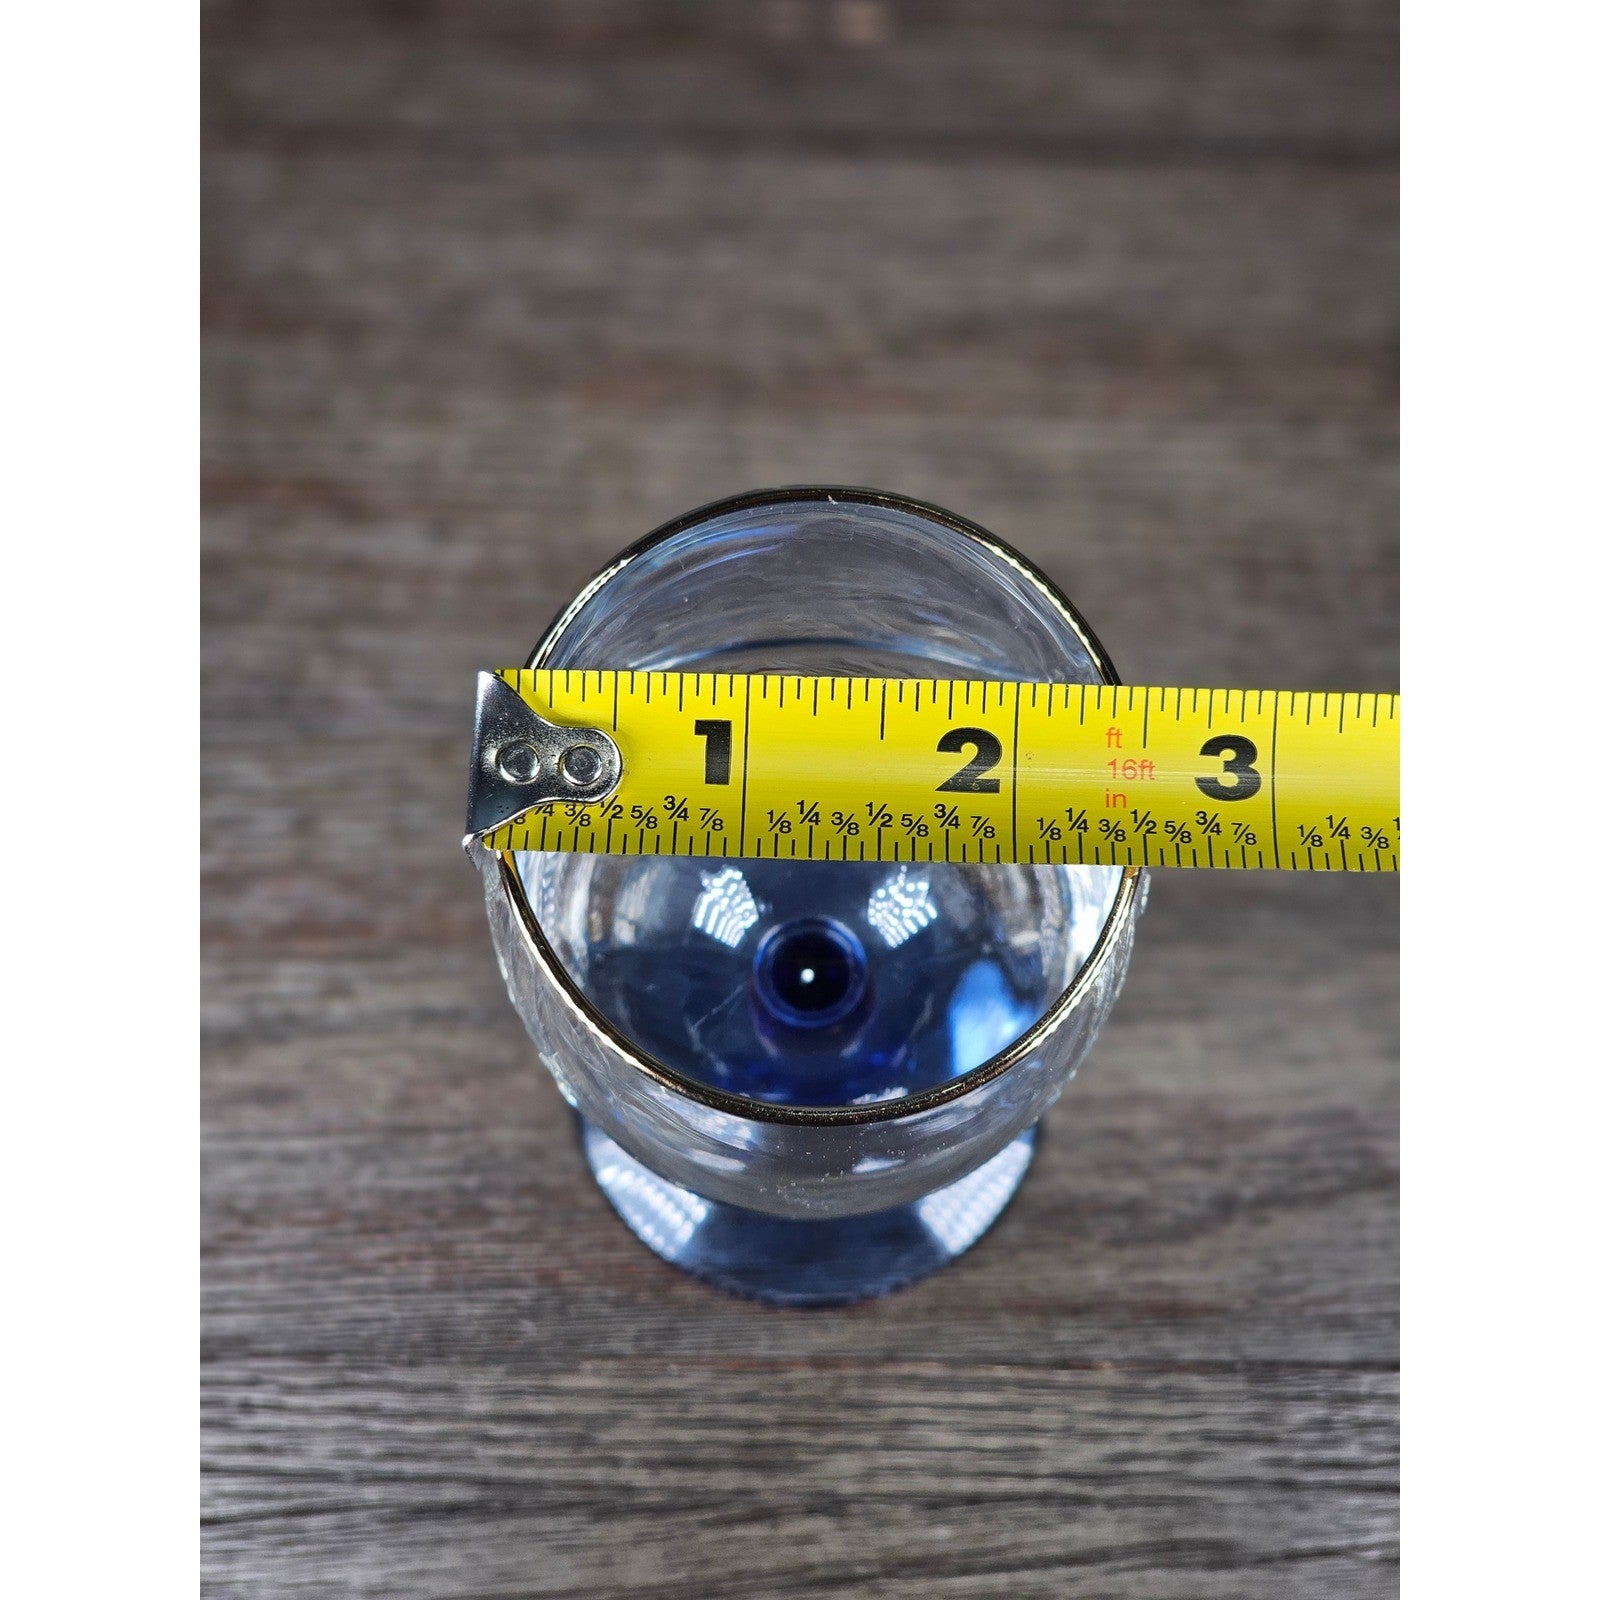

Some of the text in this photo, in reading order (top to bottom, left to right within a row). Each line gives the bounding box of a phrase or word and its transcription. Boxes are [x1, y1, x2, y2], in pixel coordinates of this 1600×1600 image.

[1105, 727, 1122, 748] ft
[695, 720, 1262, 801] 1 2 3
[1107, 758, 1155, 780] 16ft
[1105, 788, 1127, 808] in
